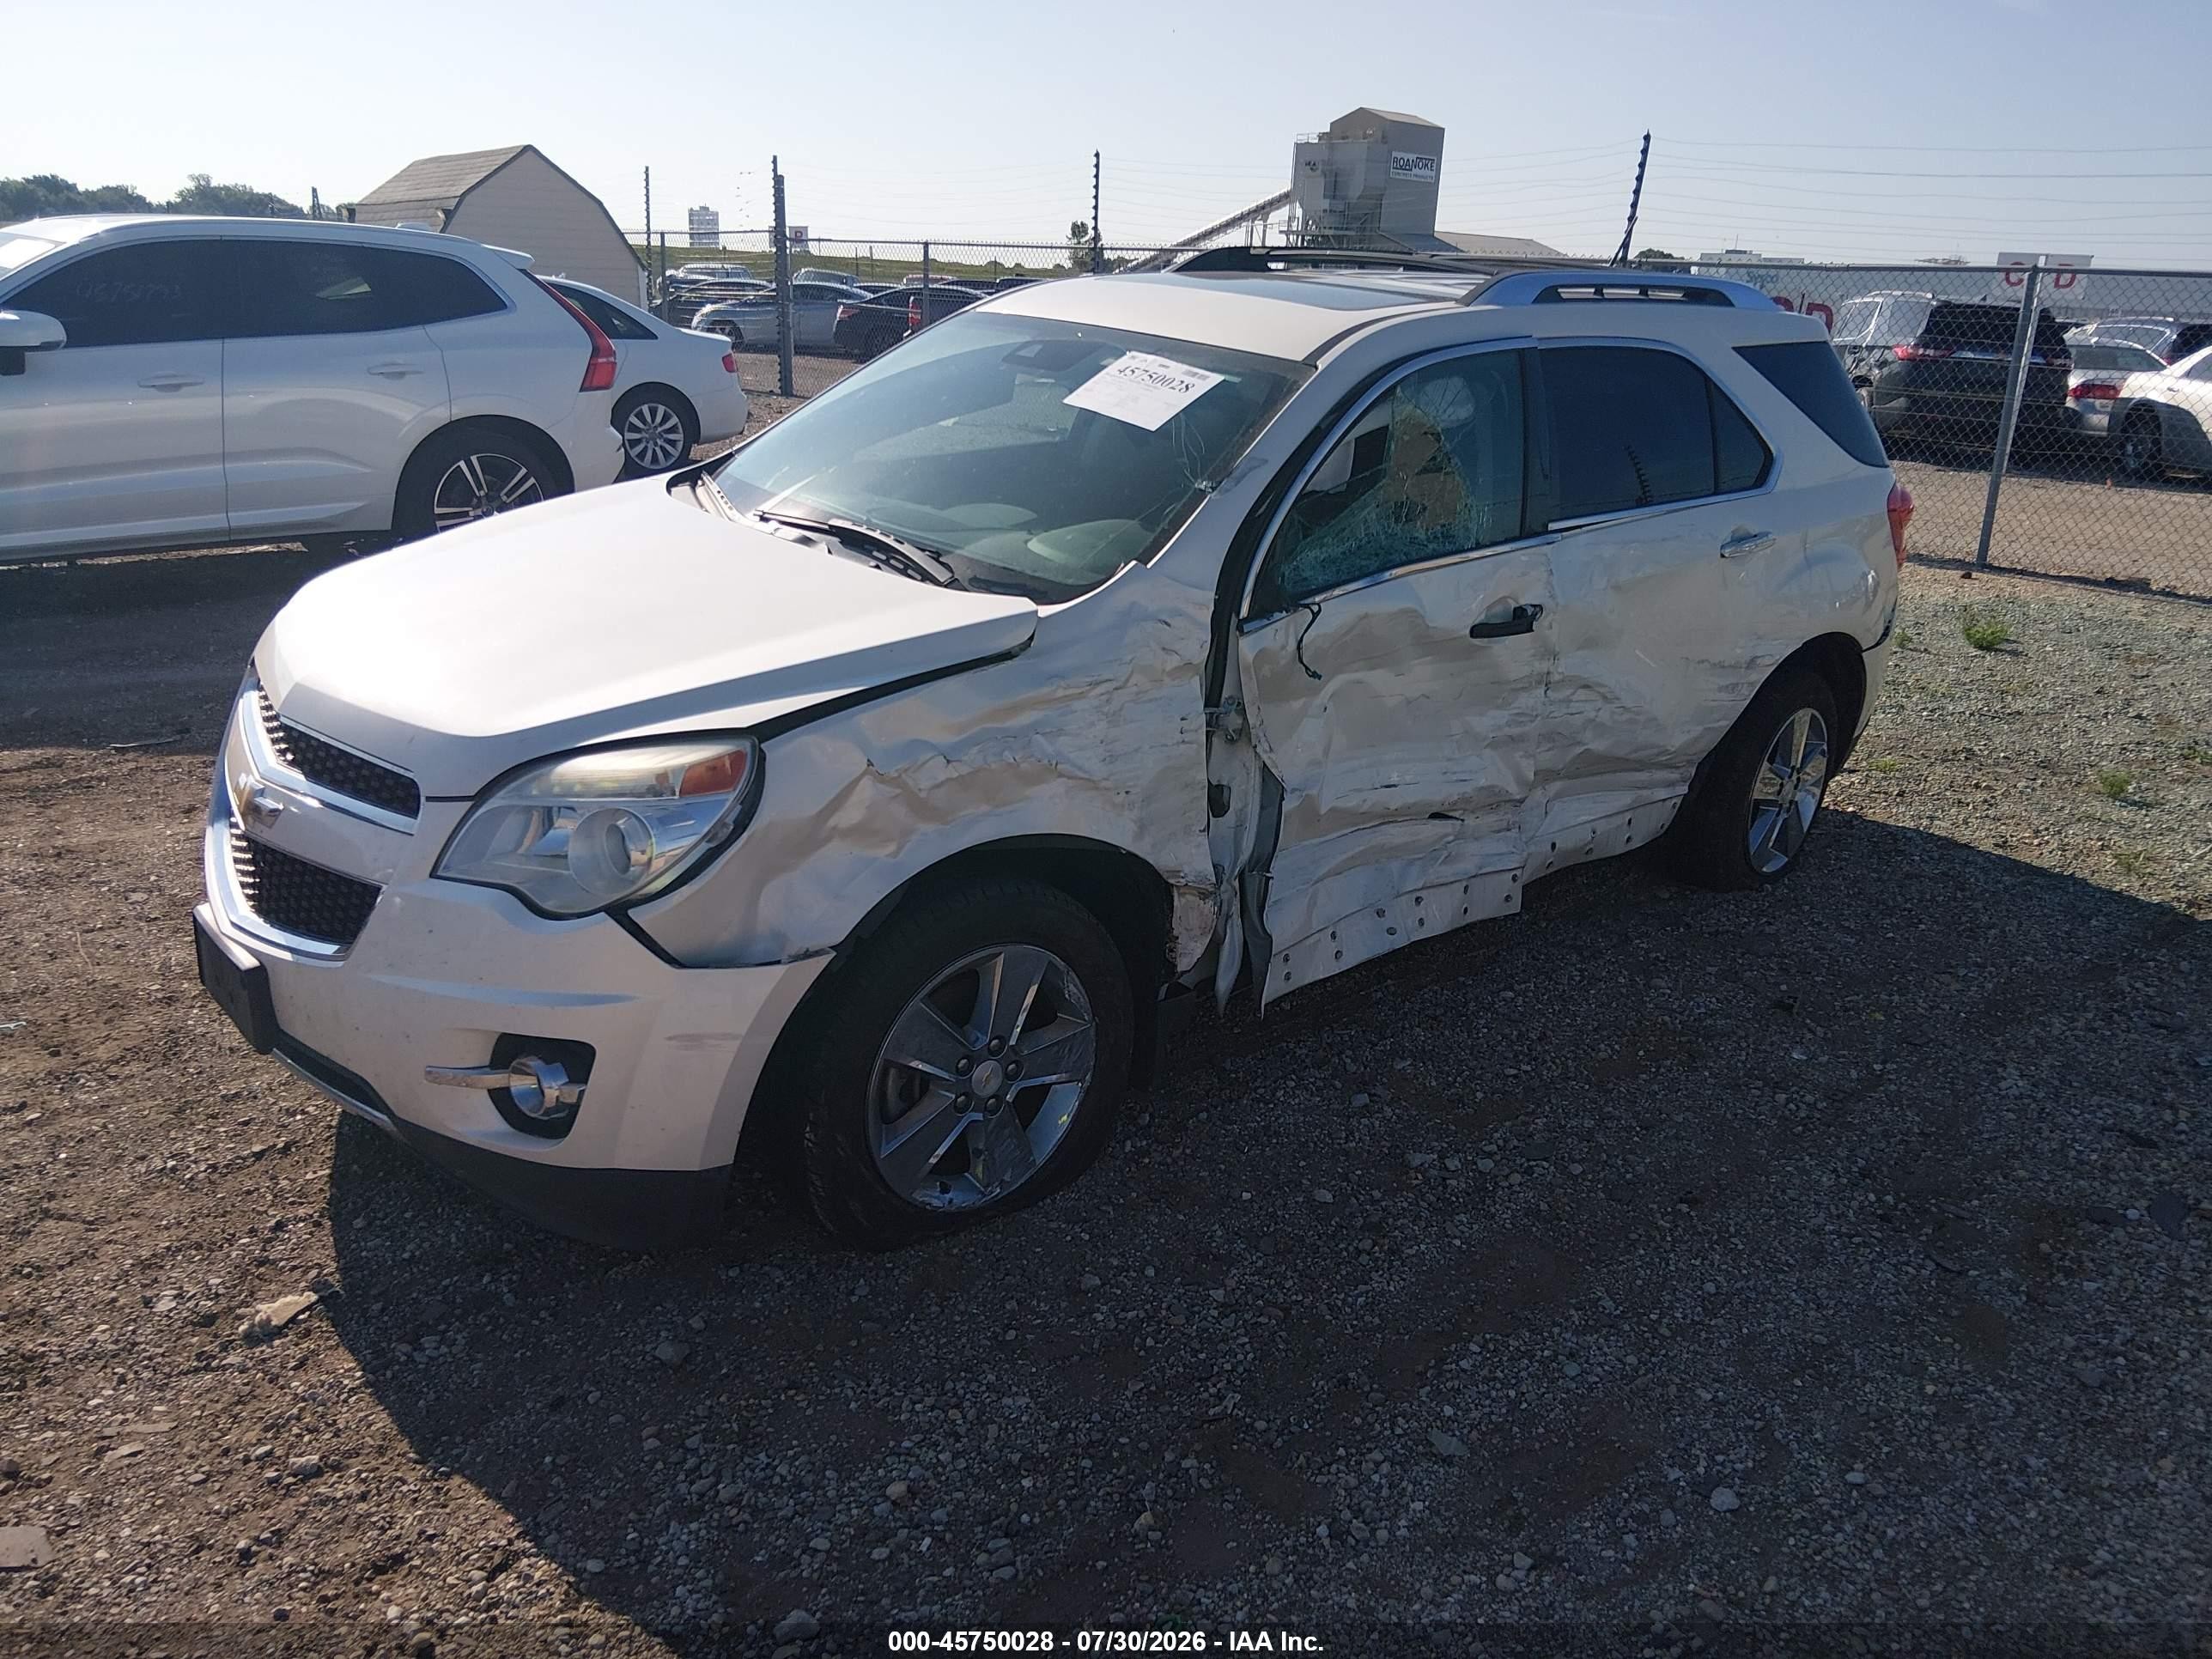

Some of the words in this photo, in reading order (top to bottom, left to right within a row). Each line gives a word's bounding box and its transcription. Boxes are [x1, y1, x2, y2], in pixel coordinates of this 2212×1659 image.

[1392, 156, 1436, 172] ROANOKE
[2005, 261, 2026, 287] C
[2053, 263, 2077, 289] D
[1116, 365, 1195, 394] 45750028
